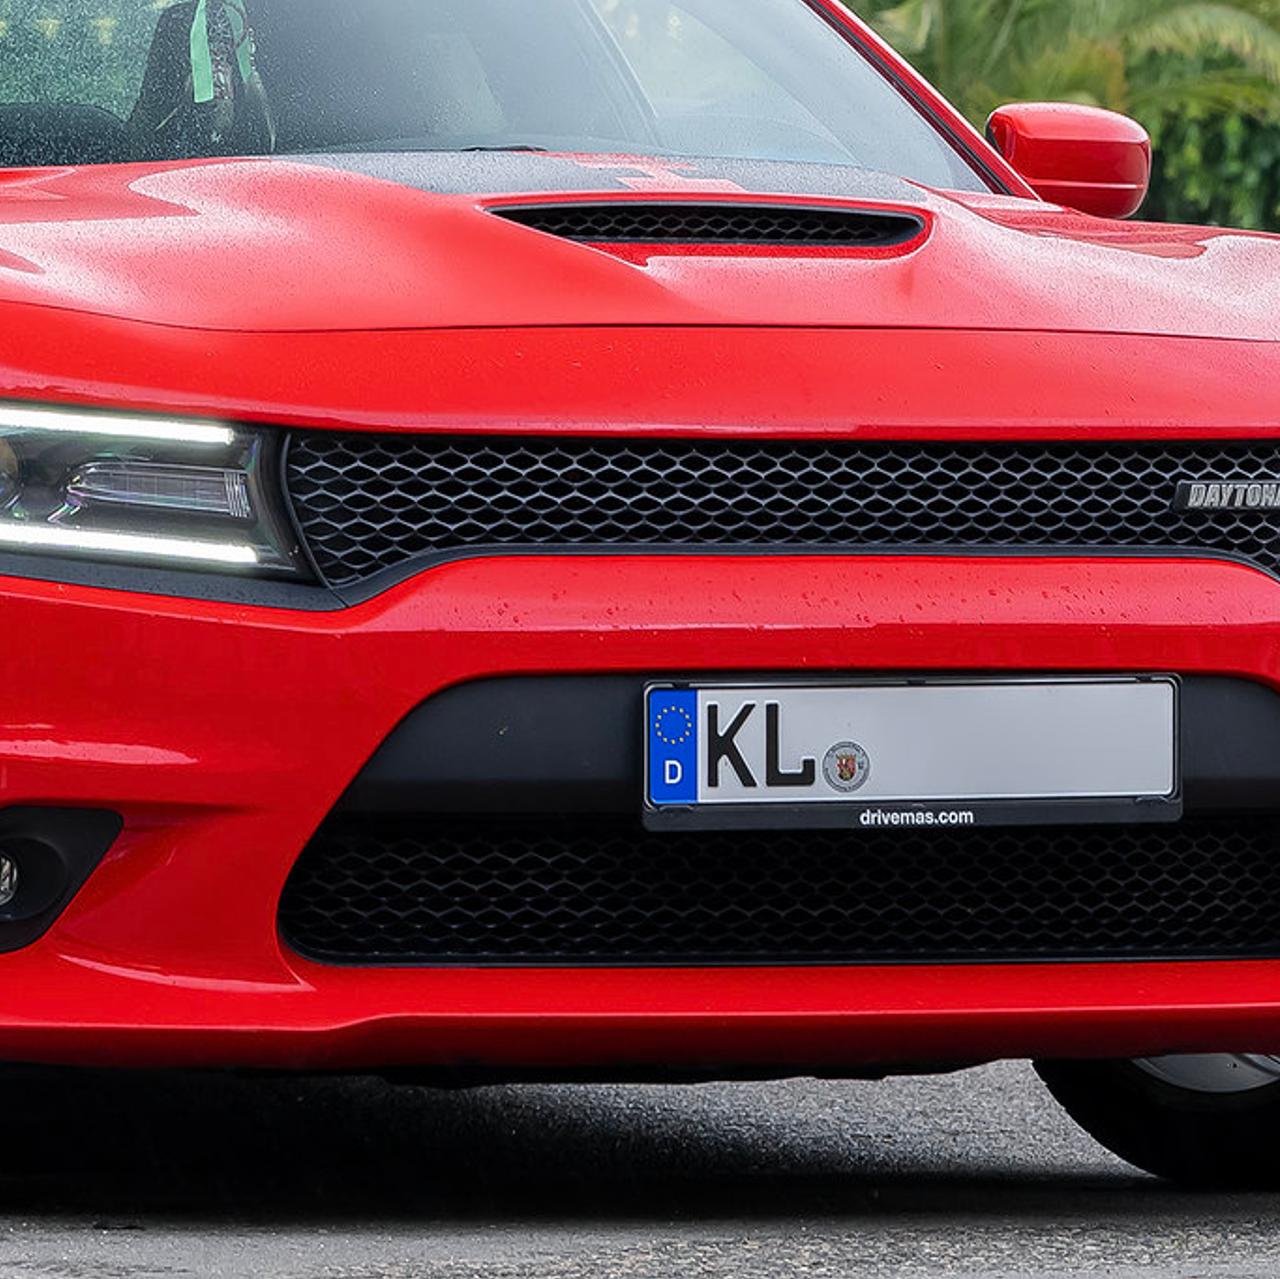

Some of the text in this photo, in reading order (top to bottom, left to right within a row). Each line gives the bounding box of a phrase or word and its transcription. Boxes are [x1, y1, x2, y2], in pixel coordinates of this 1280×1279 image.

[707, 703, 816, 788] KL
[664, 759, 683, 785] D
[859, 808, 975, 826] drivemas.com
